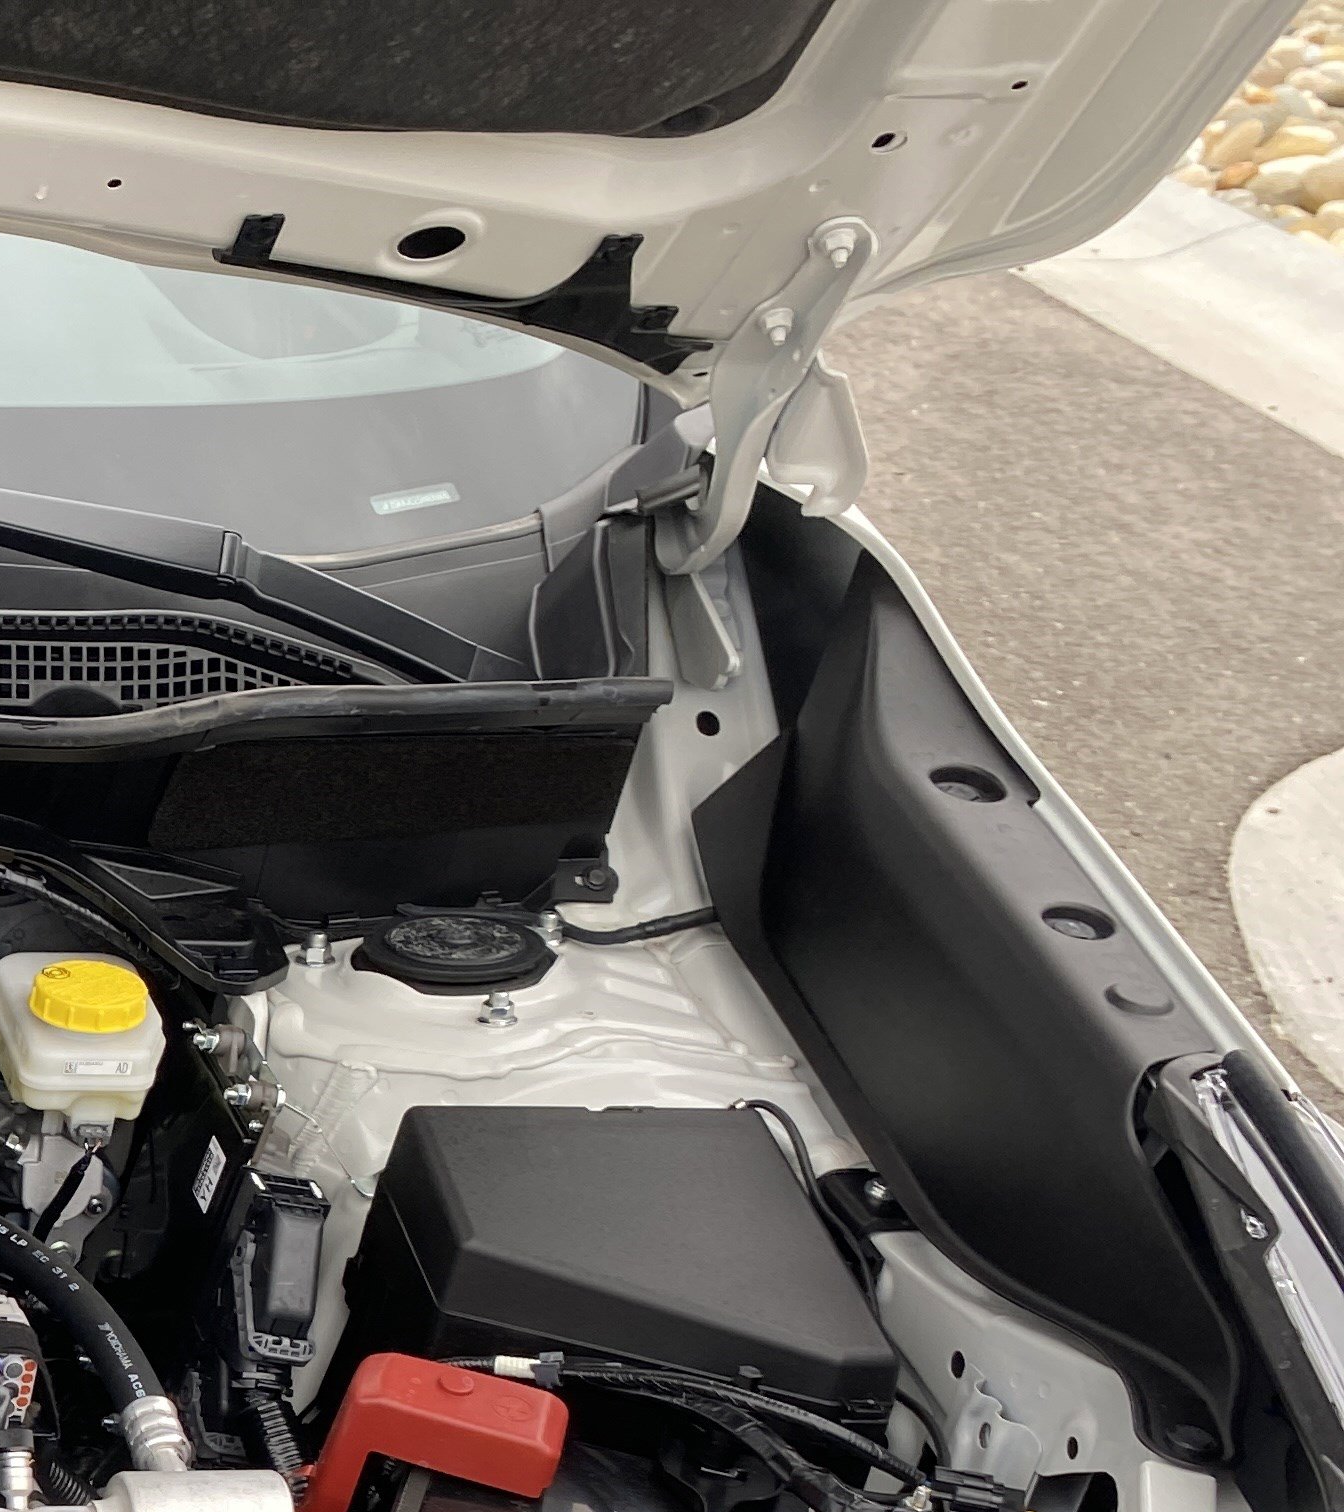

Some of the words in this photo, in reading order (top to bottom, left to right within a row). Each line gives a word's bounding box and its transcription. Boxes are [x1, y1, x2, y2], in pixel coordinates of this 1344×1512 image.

[10, 1233, 29, 1248] LP
[31, 1249, 50, 1264] EC
[105, 1330, 133, 1370] YOKOHAMA
